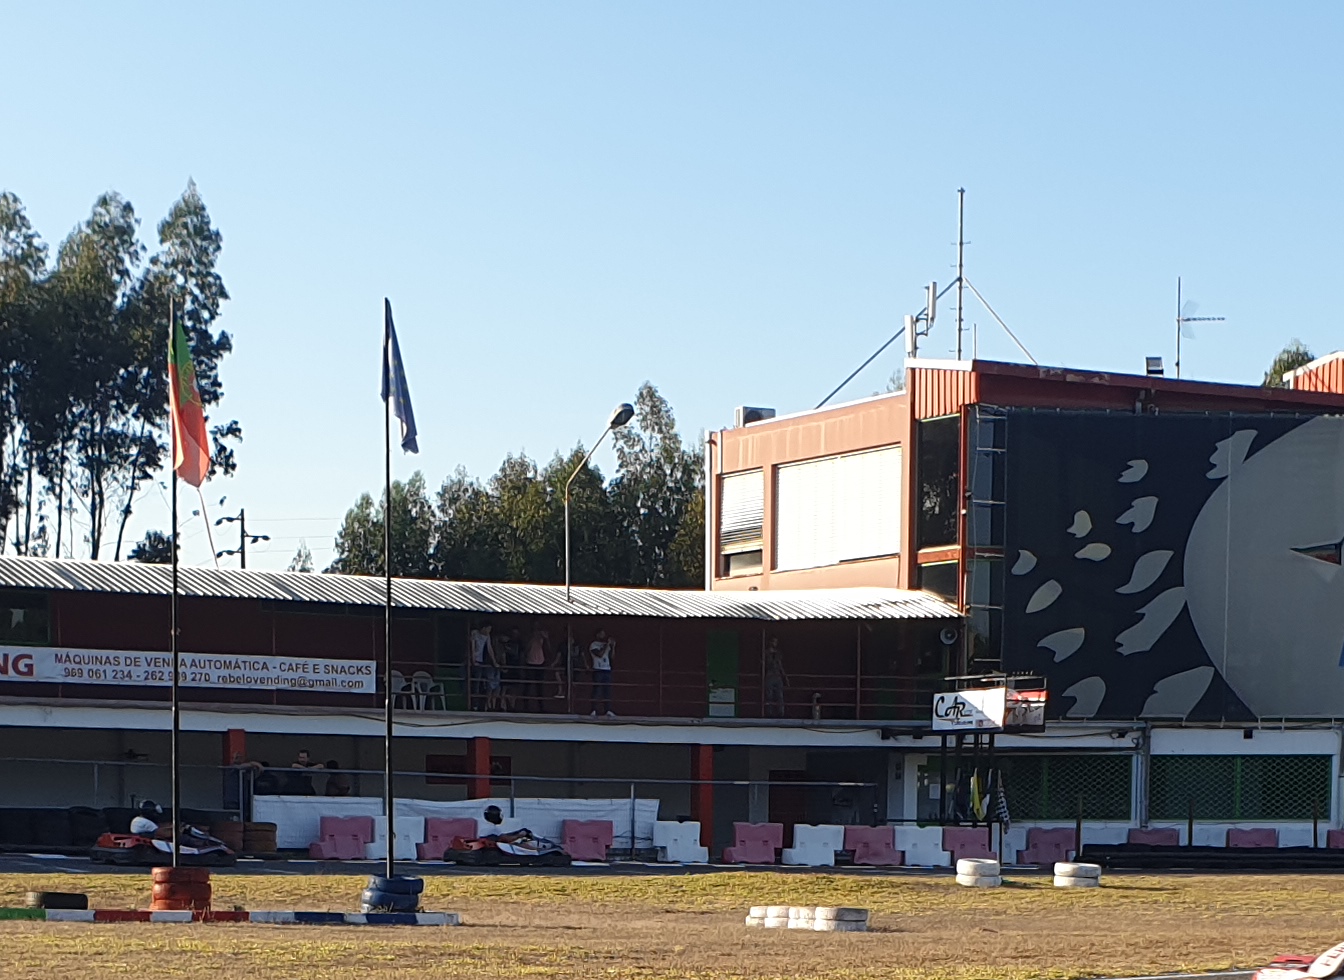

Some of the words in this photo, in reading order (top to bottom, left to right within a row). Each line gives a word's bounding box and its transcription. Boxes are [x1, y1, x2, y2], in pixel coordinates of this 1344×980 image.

[54, 651, 121, 667] MÁQUINAS
[125, 656, 142, 667] DE
[190, 658, 269, 672] AUTOMÁTICA
[279, 660, 307, 673] CAFÉ
[313, 663, 320, 674] E
[324, 664, 372, 676] SNACKS
[64, 667, 83, 678] 969
[87, 668, 106, 680] 061
[112, 670, 133, 680] 234
[144, 670, 164, 681] 262
[191, 671, 210, 682] 270
[217, 673, 364, 689] rebelovending@gmail.com
